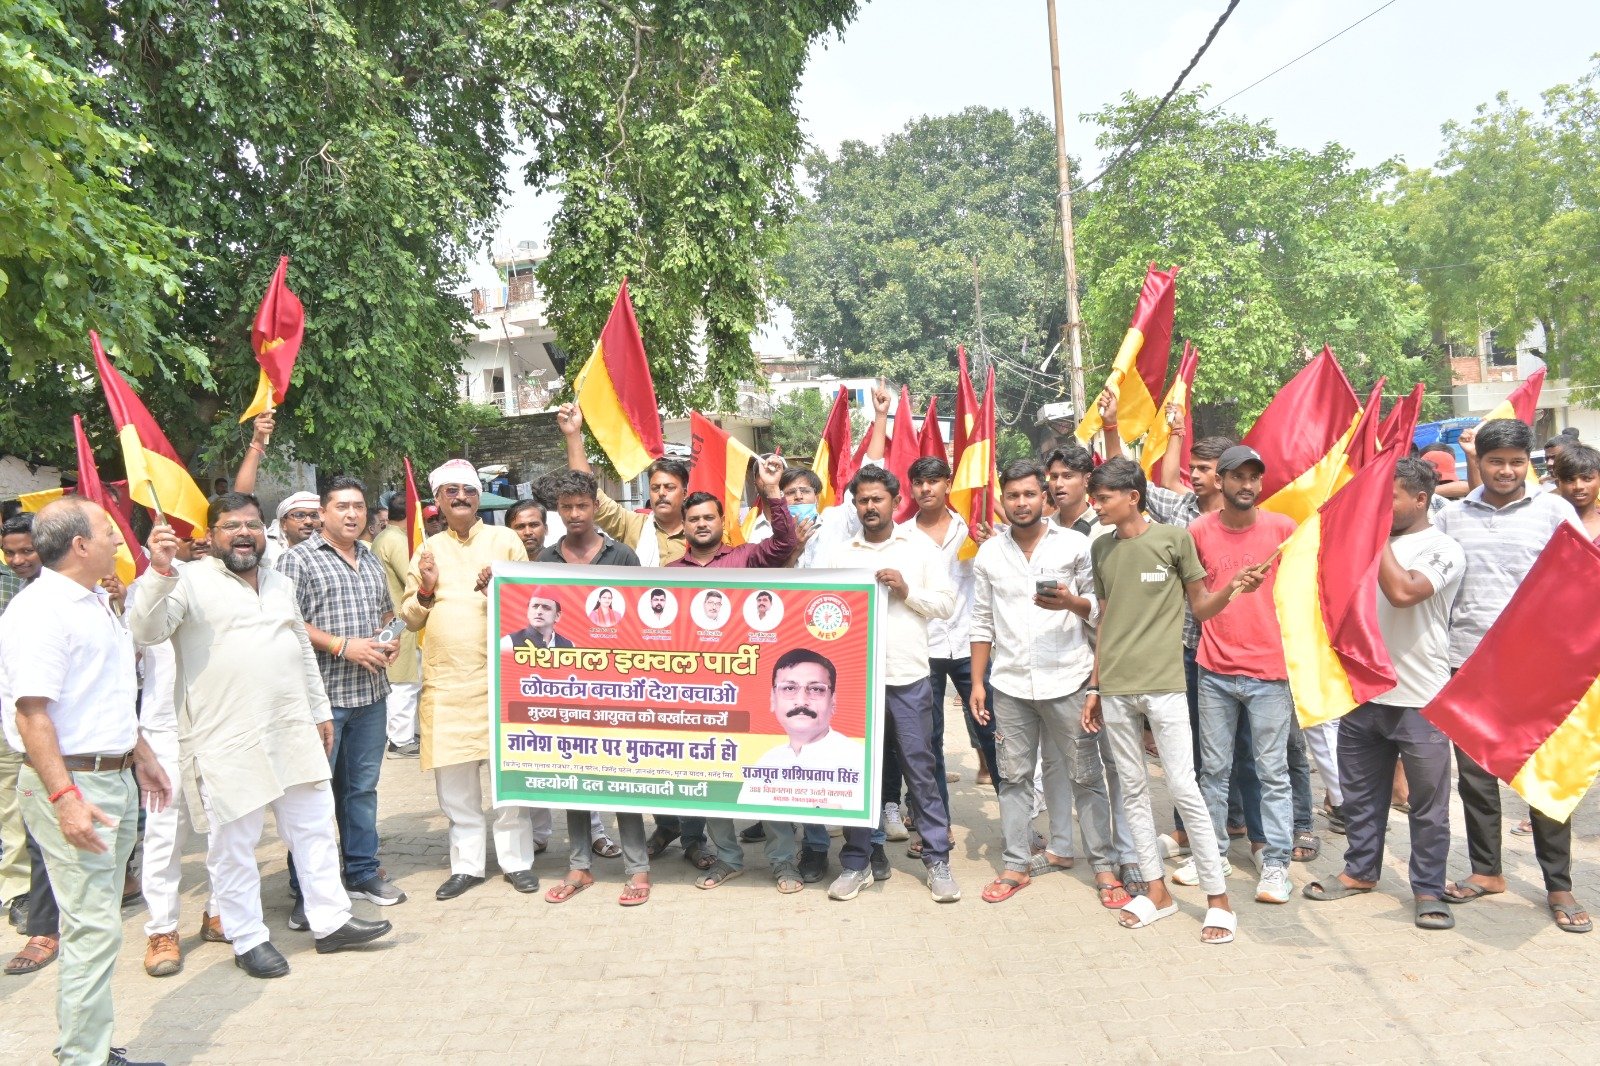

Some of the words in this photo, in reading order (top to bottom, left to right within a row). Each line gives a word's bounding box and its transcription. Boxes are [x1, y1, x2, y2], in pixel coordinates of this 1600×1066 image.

[1140, 572, 1166, 582] PUMA
[817, 630, 837, 639] NEP
[513, 639, 611, 671] नेशनल
[612, 648, 701, 674] इक्वल
[702, 644, 760, 675] पार्टी
[521, 676, 587, 697] लोकतंत्र
[591, 679, 646, 699] बचाओं
[649, 681, 678, 700] देश
[681, 683, 737, 703] बचाओ
[527, 706, 557, 721] मुख्य
[559, 708, 591, 722] चुनाव
[593, 709, 636, 725] आयुक्त
[638, 709, 655, 723] को
[657, 710, 701, 725] बर्खास्त
[703, 710, 728, 726] करों
[507, 729, 552, 752] ज्ञानेश
[556, 736, 598, 760] कुमार
[602, 738, 622, 756] पर
[626, 740, 684, 763] मुकदमा
[689, 738, 716, 760] दर्ज
[721, 739, 738, 761] हो
[742, 766, 779, 783] राजपूत
[782, 766, 835, 782] शशिप्रताप
[837, 768, 859, 783] सिंह
[525, 774, 578, 790] सहयोगी
[582, 778, 604, 792] दल
[607, 780, 674, 796] समाजवादी
[678, 782, 708, 797] पार्टी
